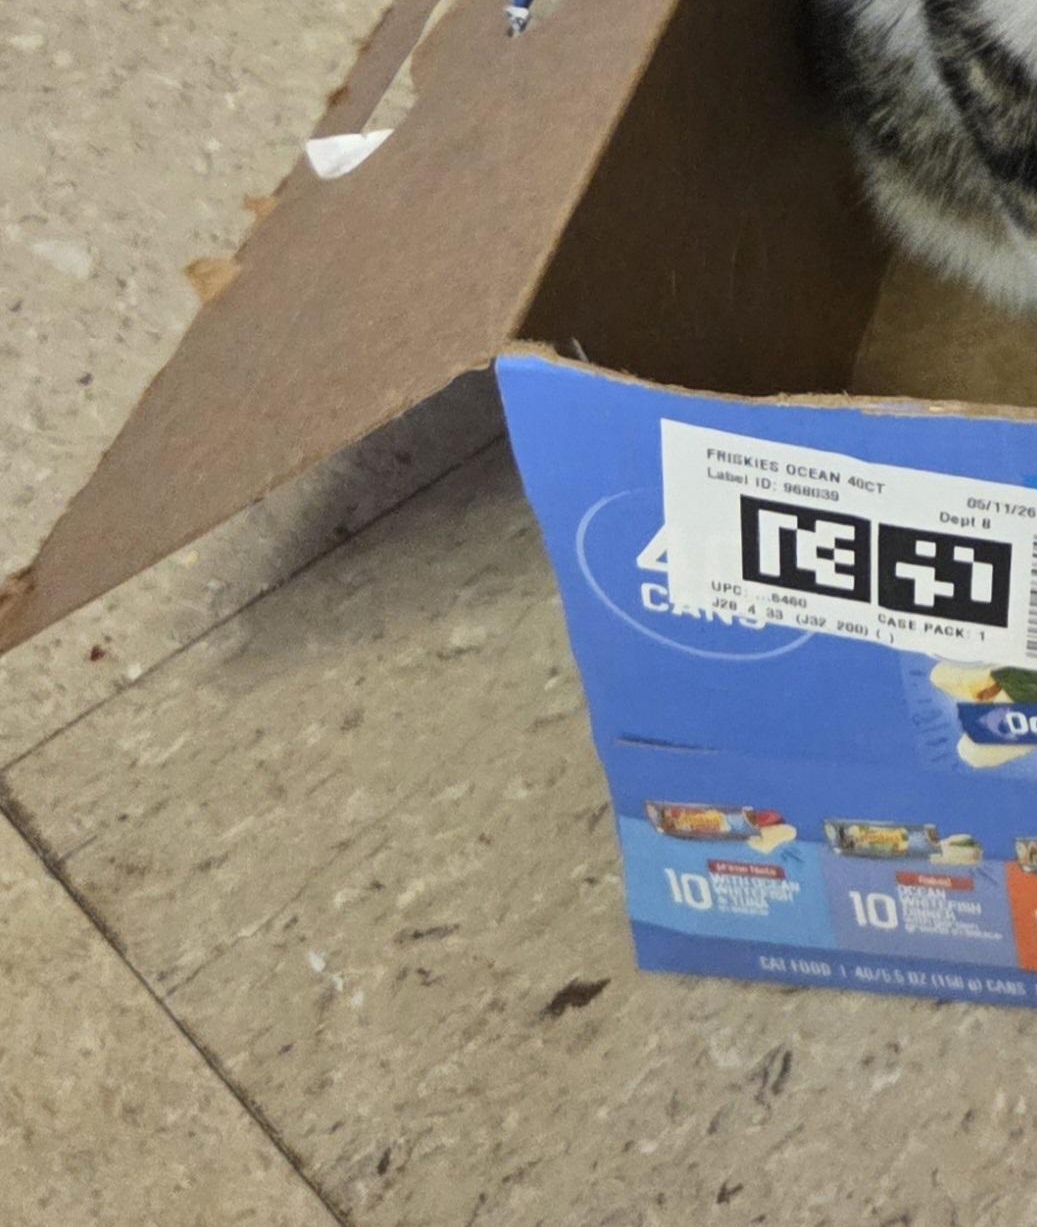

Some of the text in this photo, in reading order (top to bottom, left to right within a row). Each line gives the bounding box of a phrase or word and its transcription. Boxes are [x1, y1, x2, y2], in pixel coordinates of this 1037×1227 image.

[707, 448, 886, 494] FRISKIES OCEAN 40CT
[707, 467, 748, 485] Label
[939, 511, 975, 528] Dept
[878, 612, 918, 632] CASE
[665, 868, 713, 911] 10
[849, 890, 898, 930] 10
